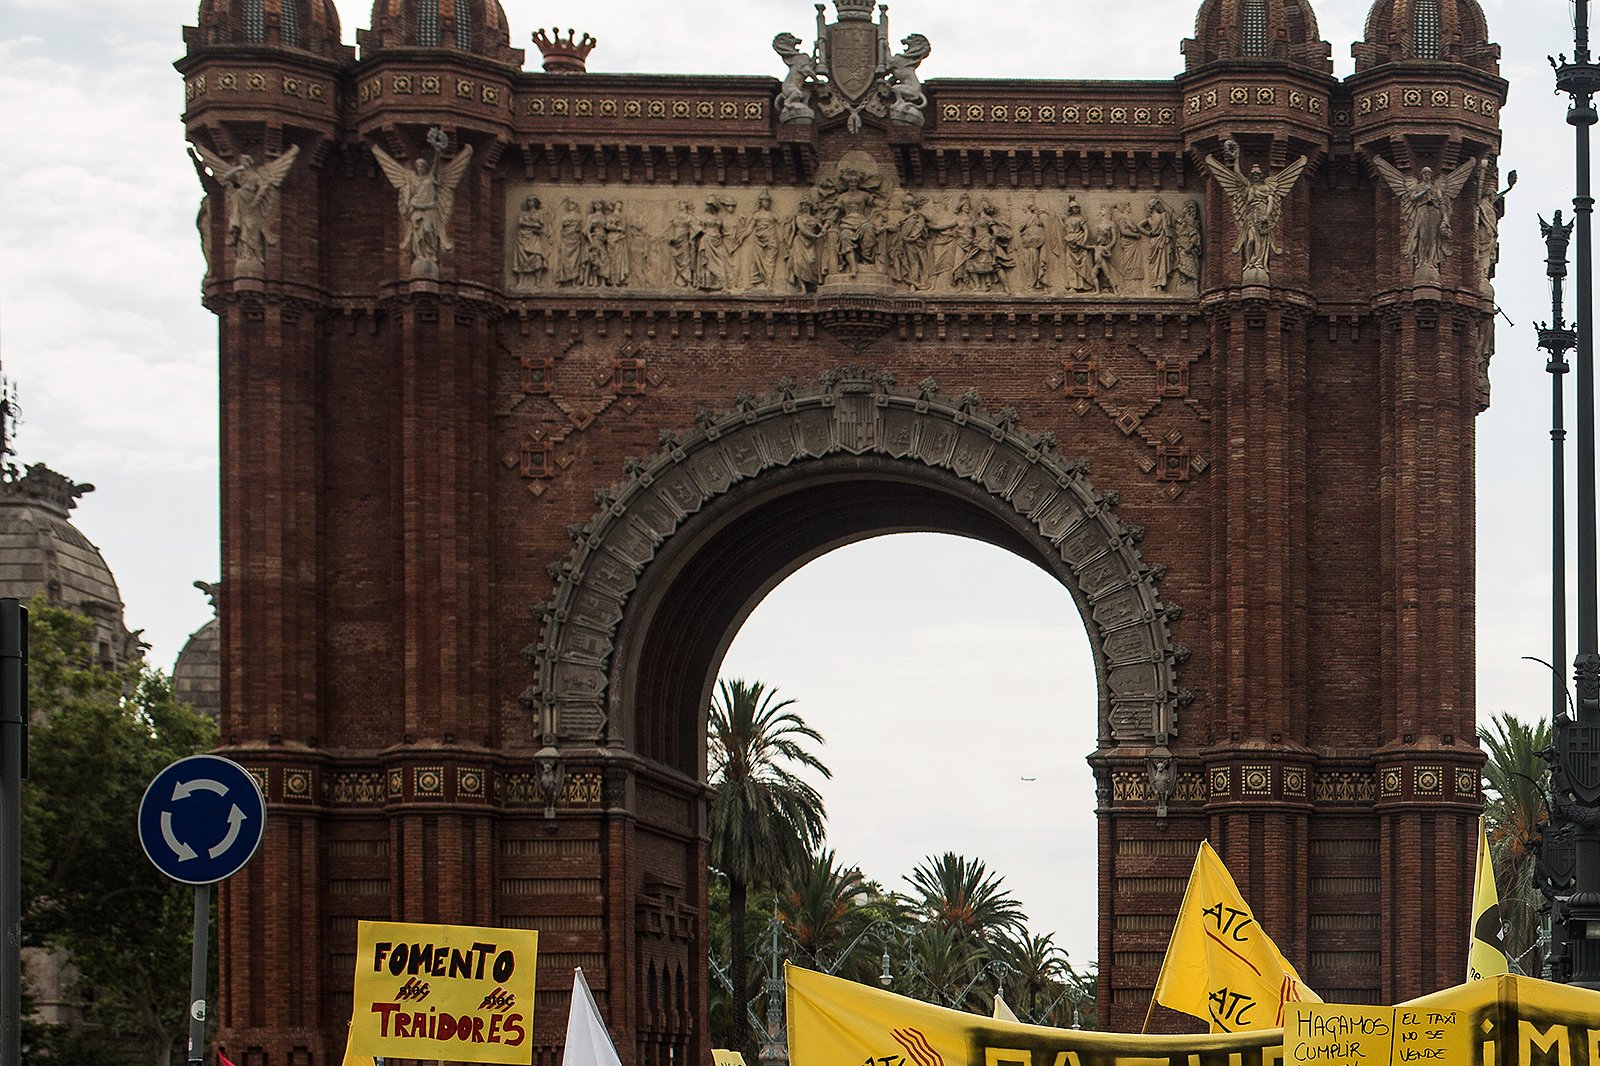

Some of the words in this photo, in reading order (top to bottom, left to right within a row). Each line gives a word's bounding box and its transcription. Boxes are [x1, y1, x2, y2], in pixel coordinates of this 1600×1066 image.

[1202, 902, 1253, 941] ATC
[374, 942, 514, 983] FOMENTO
[1208, 987, 1256, 1026] ATC
[1402, 1013, 1420, 1025] EL
[1297, 1010, 1389, 1042] HAGAMOS
[1402, 1030, 1418, 1042] NO
[1425, 1030, 1445, 1040] SE
[1400, 1048, 1448, 1062] VENDE
